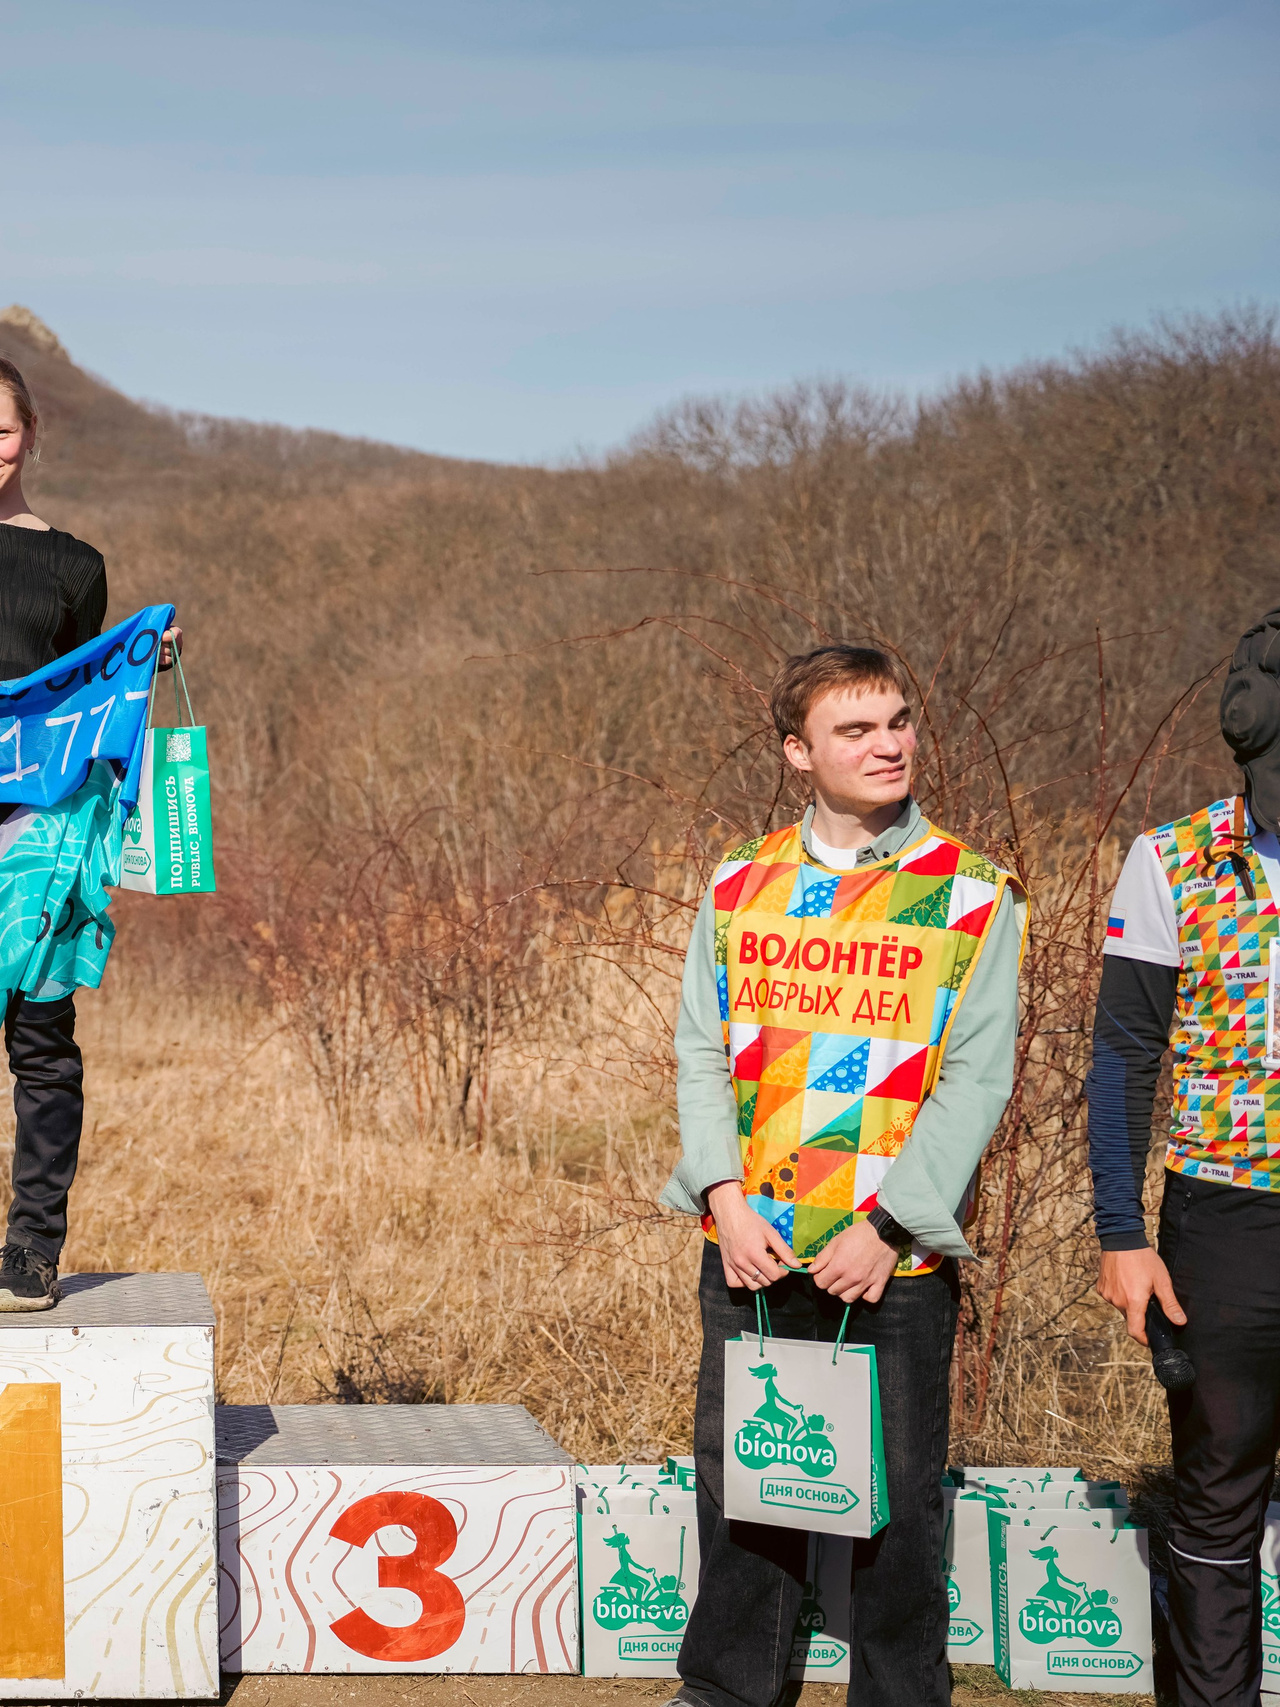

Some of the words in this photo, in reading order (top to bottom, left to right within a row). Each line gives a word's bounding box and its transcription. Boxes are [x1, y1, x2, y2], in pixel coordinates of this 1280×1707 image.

[165, 775, 183, 888] ПОДПИШИСЬ
[184, 776, 201, 887] PUBLIC_BIONOVA
[739, 931, 923, 979] ВОЛОНТЁР
[734, 977, 843, 1016] ДОБРЫХ
[852, 988, 911, 1025] ДЕЛ
[738, 1432, 835, 1468] bionova
[765, 1483, 792, 1498] ДНЯ
[796, 1486, 849, 1505] ОСНОВА
[330, 1492, 465, 1661] 3
[597, 1597, 687, 1620] bionova
[1022, 1610, 1120, 1636] bionova
[623, 1641, 649, 1654] ДНЯ
[651, 1641, 682, 1653] ОСНО
[1052, 1655, 1079, 1669] ДНЯ
[1082, 1656, 1134, 1670] ОСНОВА
